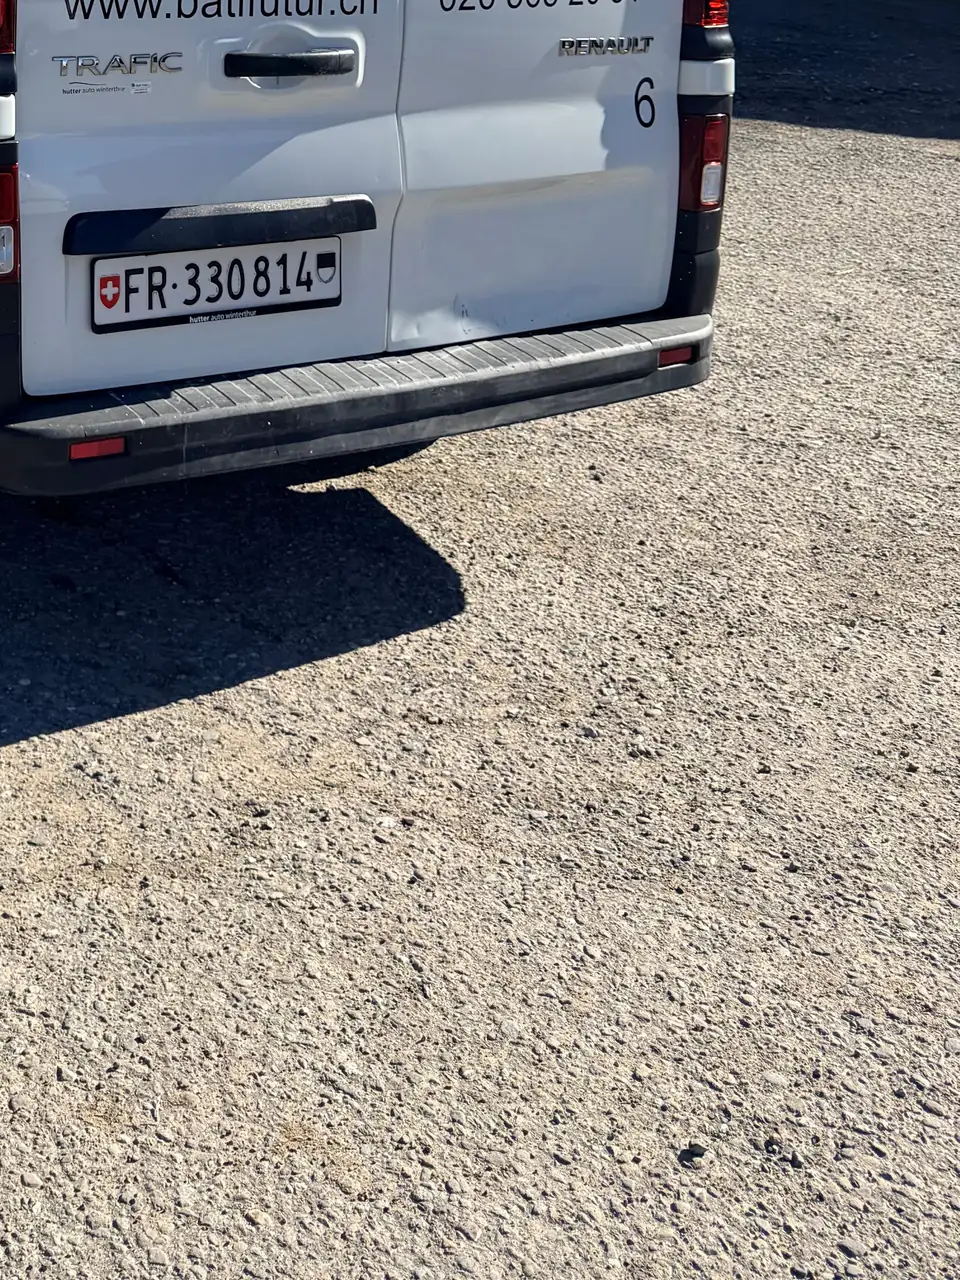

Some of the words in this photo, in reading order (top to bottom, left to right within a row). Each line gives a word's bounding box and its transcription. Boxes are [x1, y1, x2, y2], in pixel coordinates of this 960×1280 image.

[558, 36, 654, 57] RENAULT
[51, 52, 183, 76] TRAFIC
[62, 86, 81, 95] hutter
[82, 86, 95, 94] auto
[634, 76, 656, 128] 6
[189, 315, 210, 323] hutter
